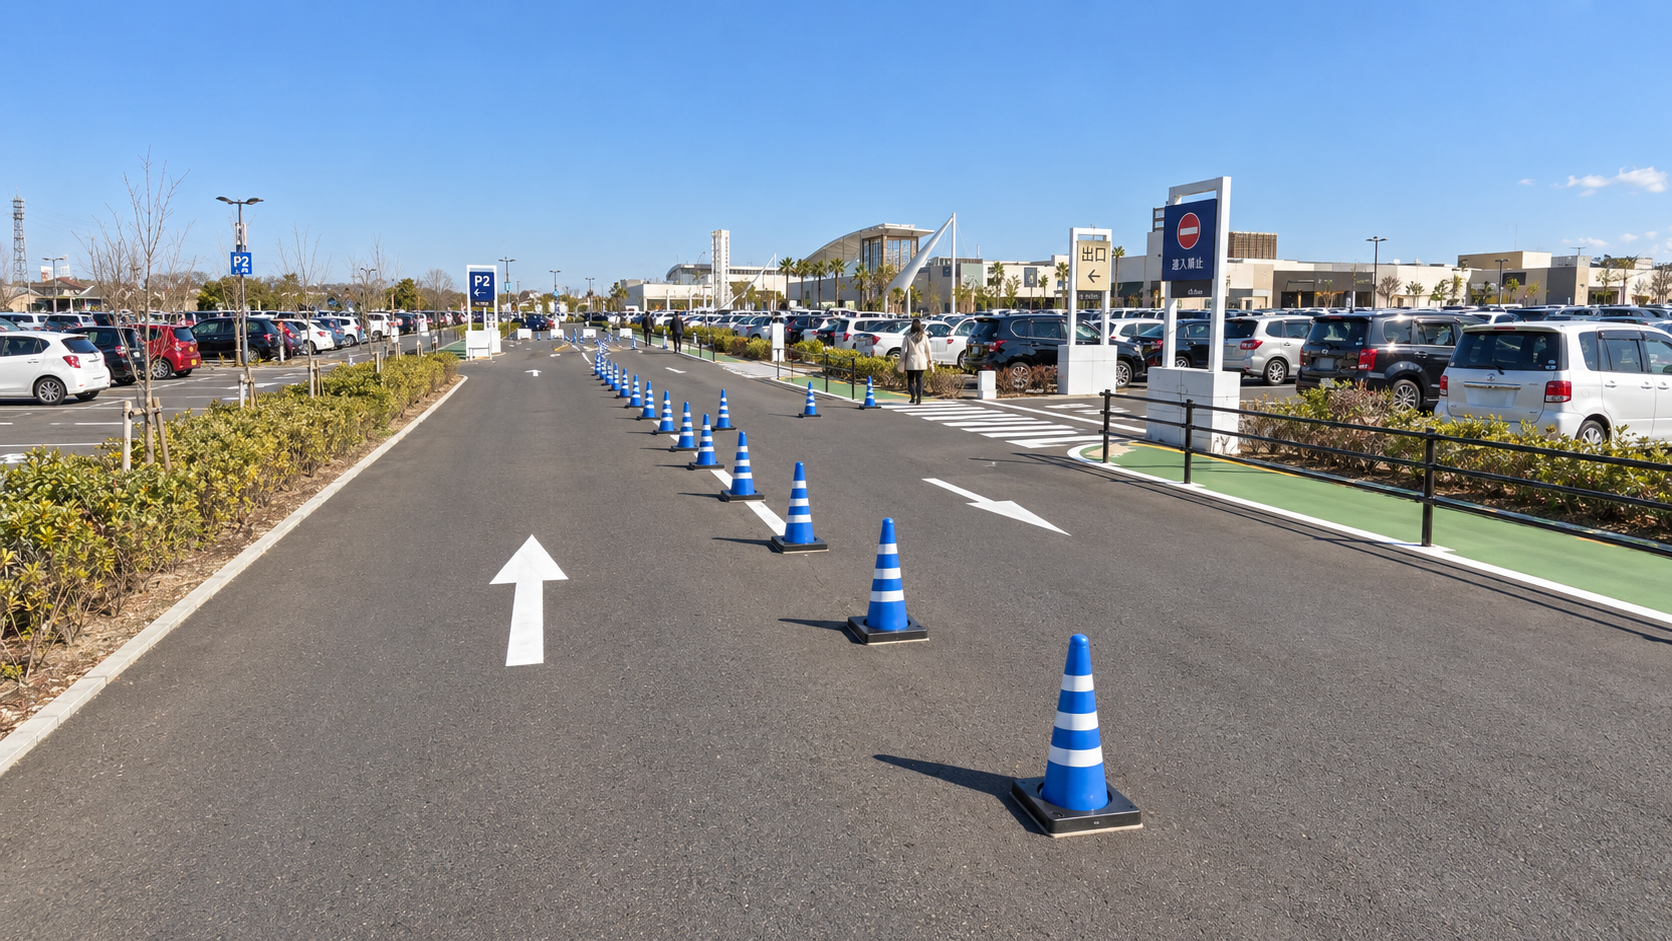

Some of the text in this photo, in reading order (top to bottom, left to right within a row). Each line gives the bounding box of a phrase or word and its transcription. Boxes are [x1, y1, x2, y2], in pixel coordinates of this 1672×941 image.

[1081, 246, 1106, 263] 出口
[233, 255, 249, 268] P2
[474, 275, 490, 287] P2
